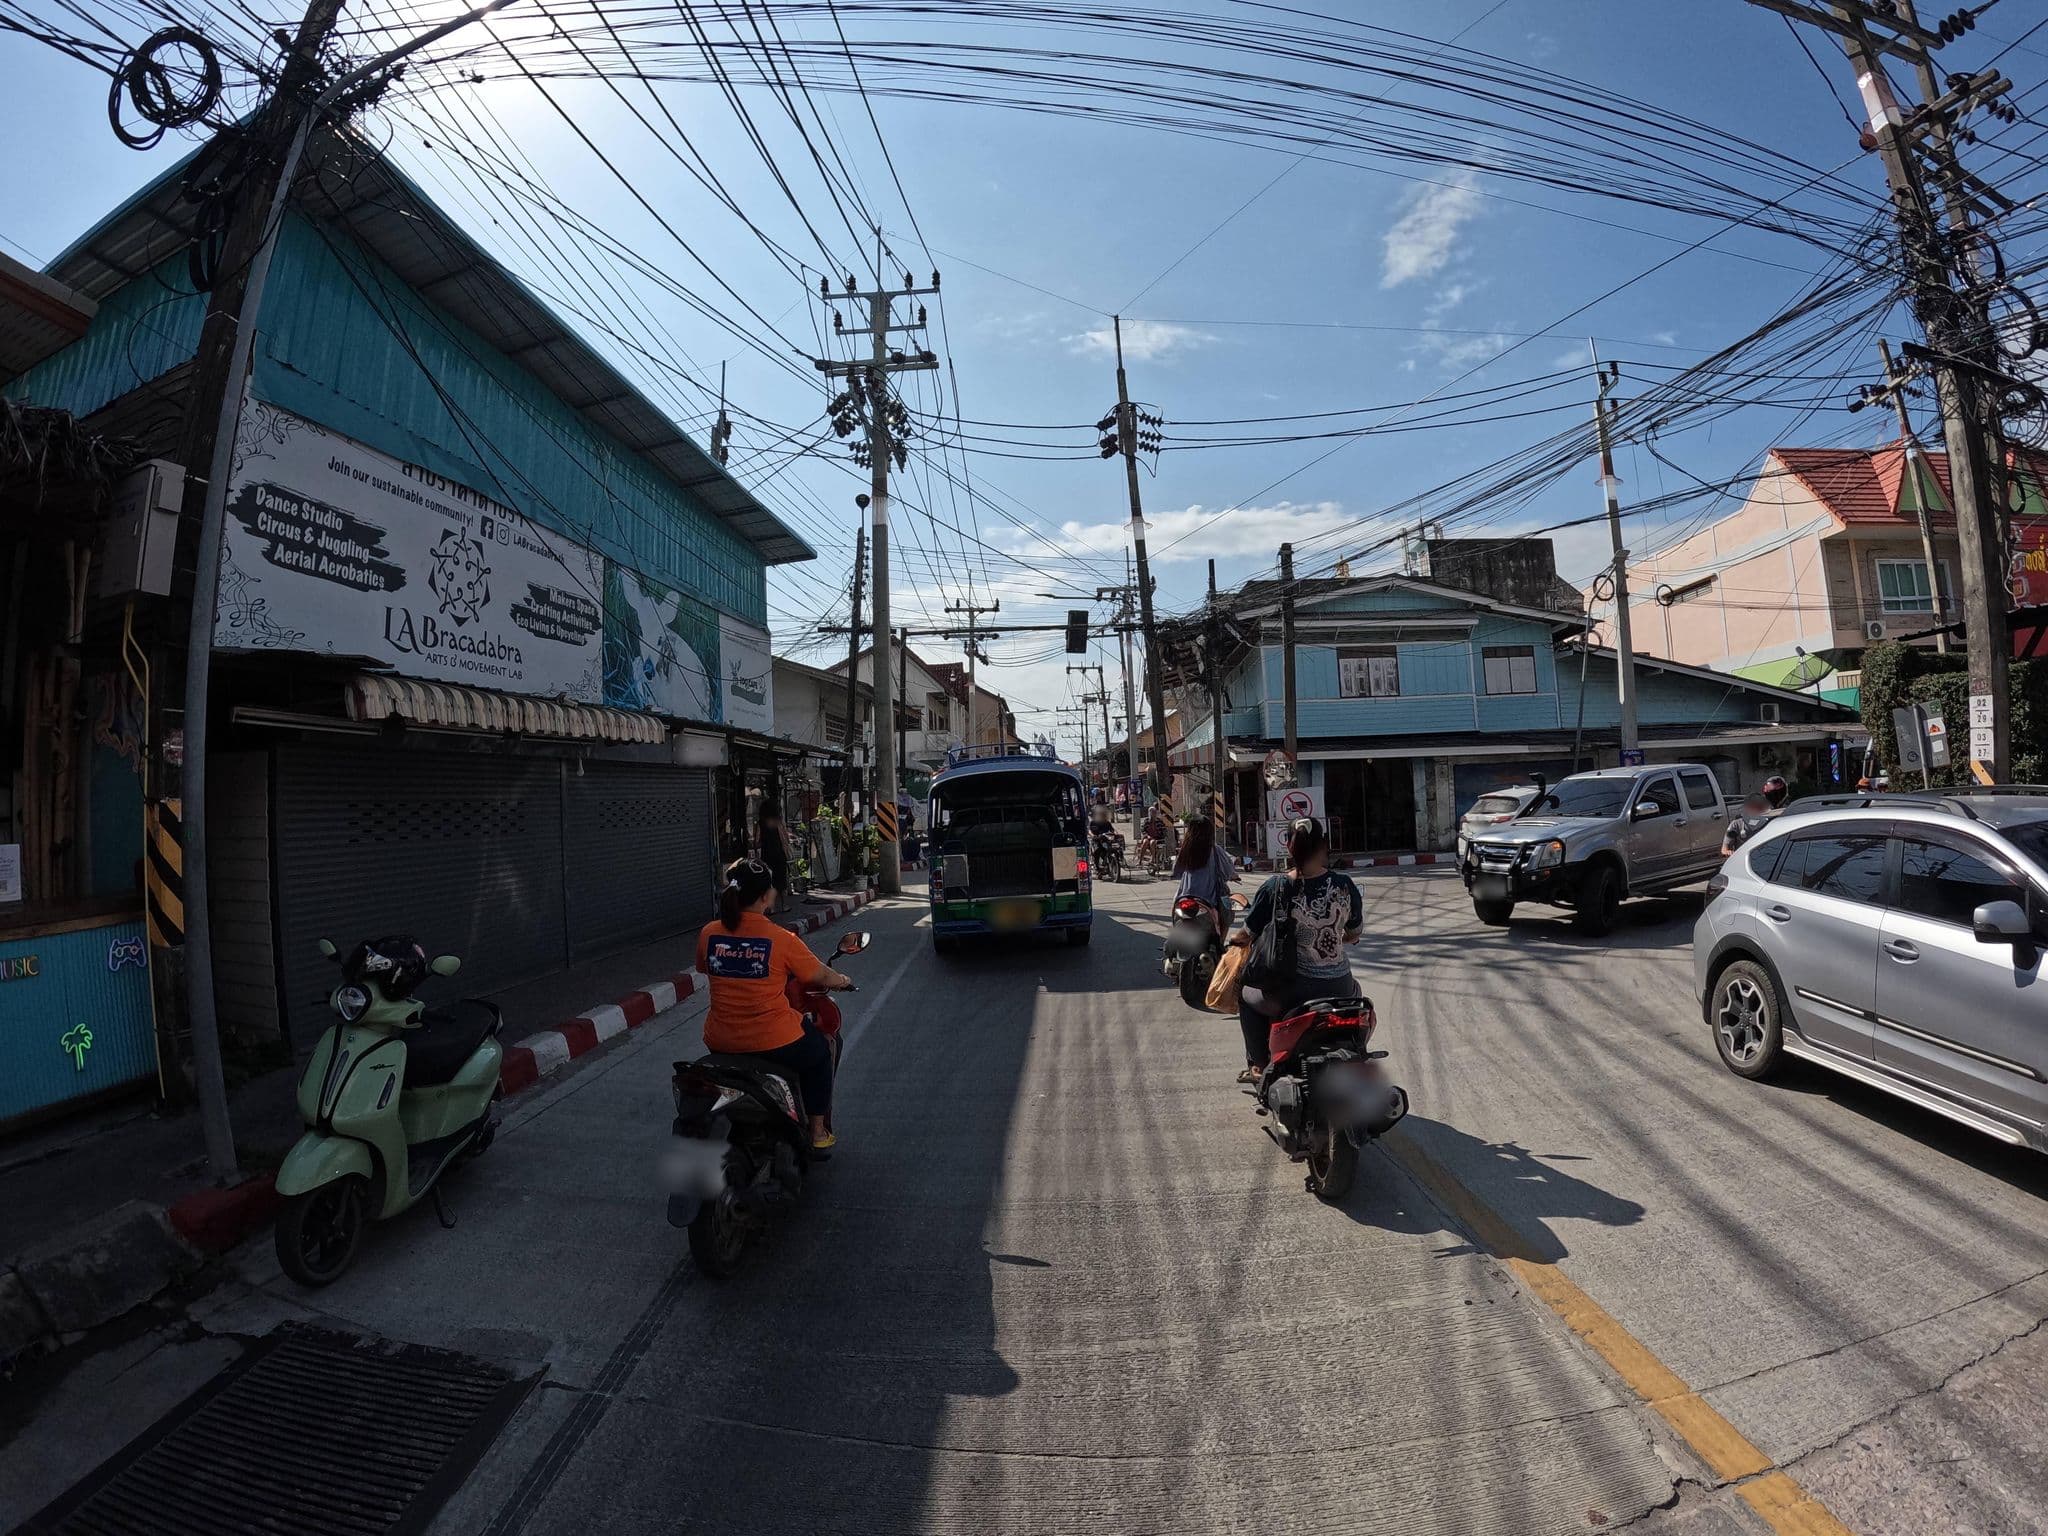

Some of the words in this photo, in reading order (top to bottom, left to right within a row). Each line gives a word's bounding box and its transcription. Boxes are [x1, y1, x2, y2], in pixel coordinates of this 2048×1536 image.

[328, 456, 350, 477] Join
[352, 467, 370, 484] our
[372, 475, 424, 506] sustainable
[425, 498, 474, 528] community!
[256, 486, 298, 517] Dance
[302, 501, 343, 531] Studio
[257, 511, 301, 542] Circus
[303, 526, 315, 544] &
[317, 531, 370, 564] Juggling
[274, 542, 316, 571] Aerial
[318, 555, 385, 589] Acrobatics
[549, 587, 576, 610] Makers
[516, 612, 529, 628] Eco
[529, 617, 550, 635] Living
[530, 598, 561, 623] Crafting
[561, 609, 593, 631] Activities
[384, 606, 523, 665] LABracadabra
[424, 652, 448, 666] ARTS
[459, 660, 507, 677] MOVEMENT
[508, 669, 523, 680] LAB
[1976, 698, 1987, 707] 02
[1977, 714, 1987, 723] 29
[1976, 733, 1987, 741] 03
[1977, 748, 1987, 757] 27
[745, 947, 766, 962] Bay
